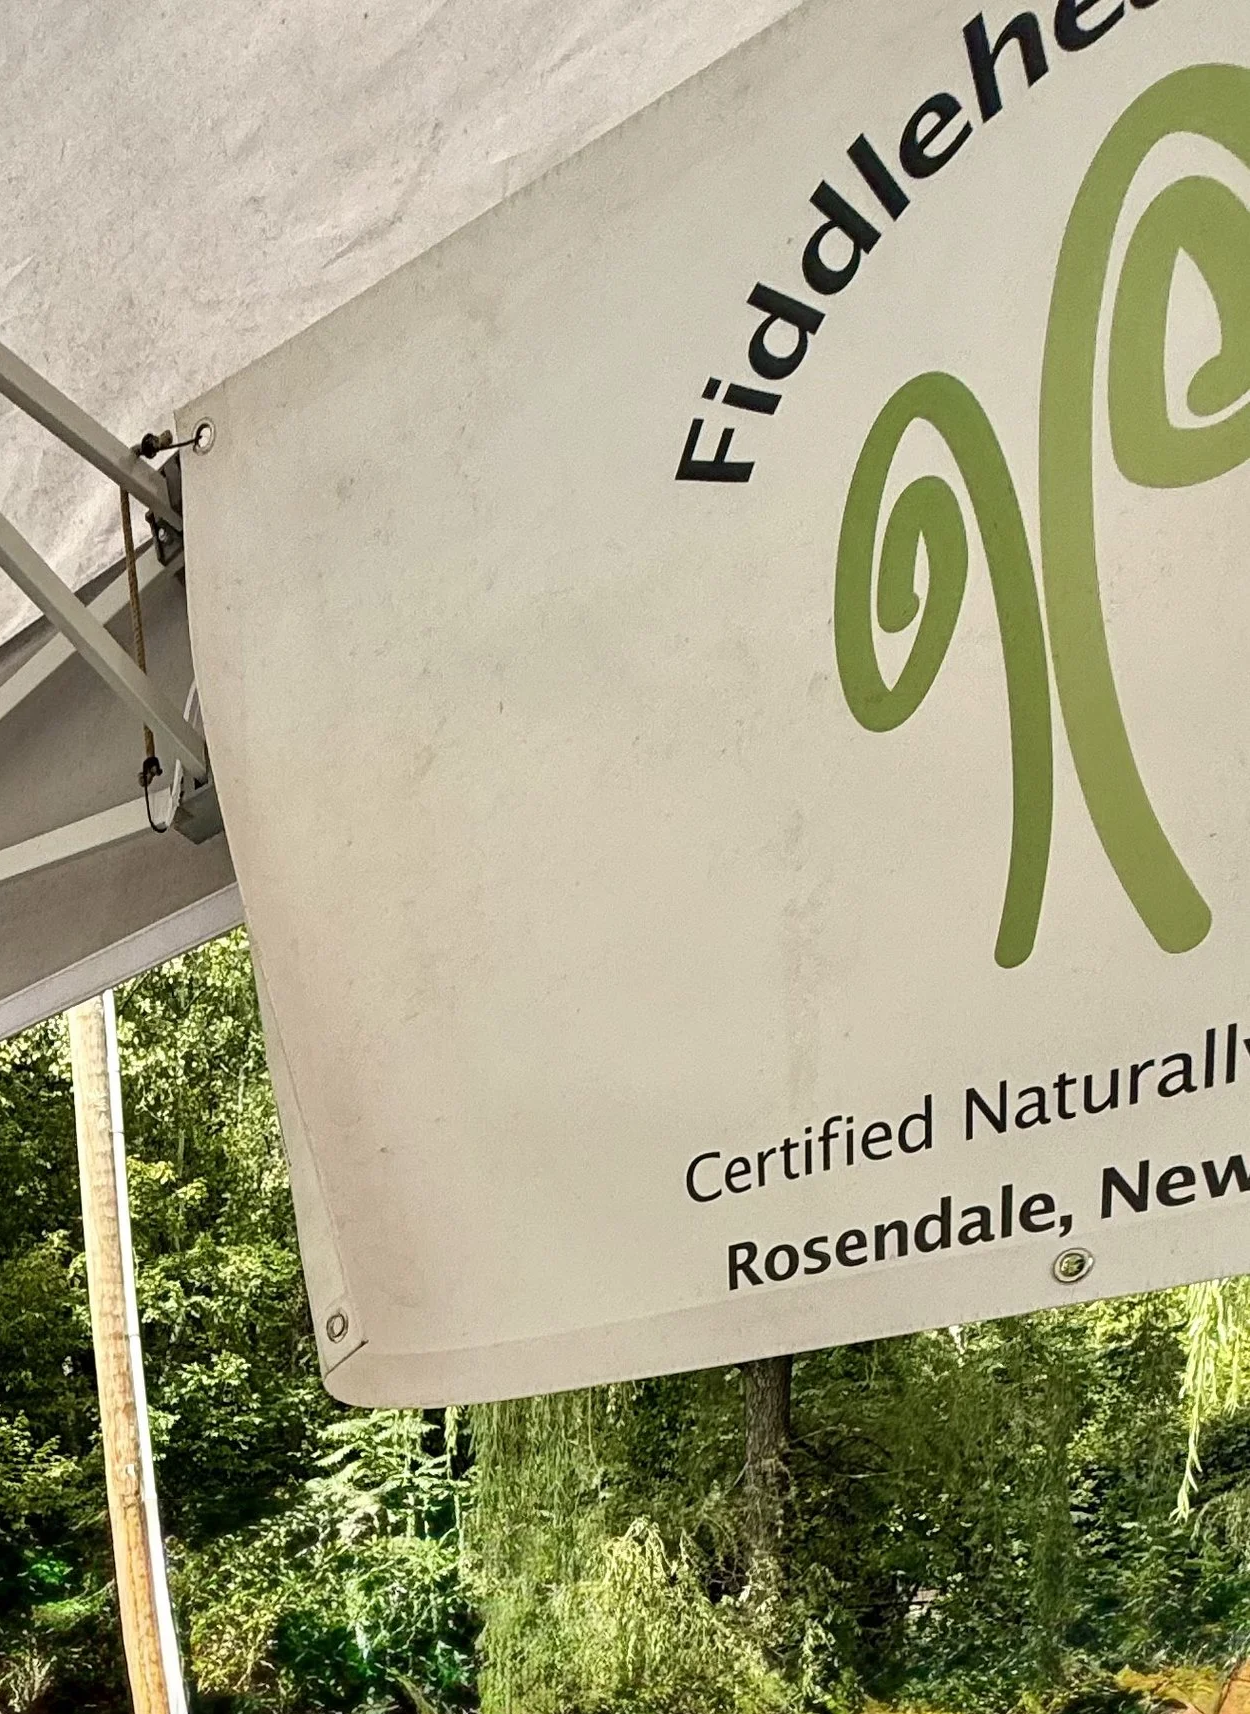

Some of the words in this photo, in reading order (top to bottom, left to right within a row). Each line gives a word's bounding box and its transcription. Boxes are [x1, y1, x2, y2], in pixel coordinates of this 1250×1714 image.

[675, 0, 1159, 483] Fiddlehe
[685, 1094, 933, 1202] Certified
[965, 1023, 1250, 1141] Naturall
[727, 1185, 1074, 1290] Rosendale,
[1100, 1154, 1250, 1219] New
